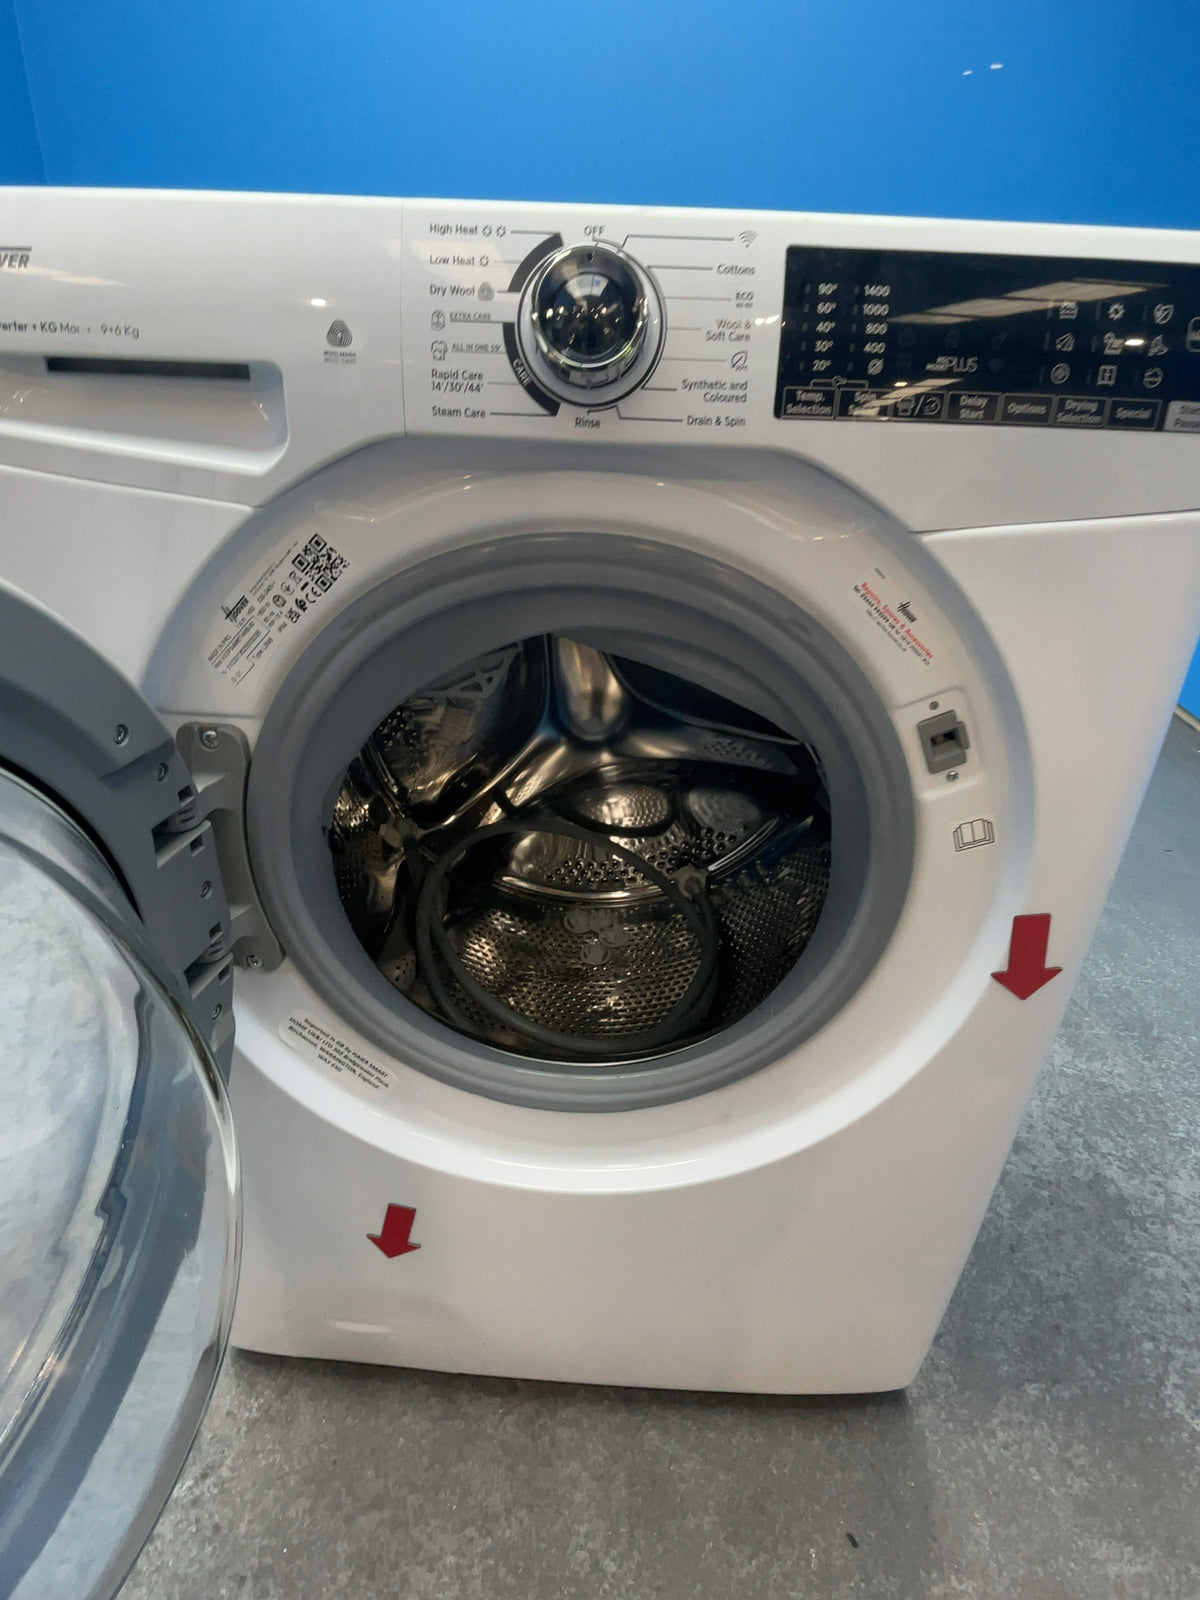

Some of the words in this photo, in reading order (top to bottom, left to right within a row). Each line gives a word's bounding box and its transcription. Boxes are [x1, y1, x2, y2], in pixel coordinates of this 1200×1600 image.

[429, 223, 452, 236] High
[455, 225, 478, 235] Heat
[584, 225, 605, 236] OFF
[429, 255, 450, 265] Low
[452, 255, 475, 266] Heat
[716, 263, 756, 276] Cottons
[429, 284, 447, 297] Dry
[449, 285, 475, 296] Wool
[735, 291, 754, 301] ECO
[863, 284, 891, 297] 1400
[862, 303, 890, 316] 1000
[40, 321, 58, 334] KG
[716, 318, 742, 329] Wool
[865, 322, 888, 335] 800
[705, 331, 725, 342] Soft
[727, 331, 751, 343] Care
[863, 341, 887, 354] 400
[431, 369, 459, 382] Rapid
[461, 370, 483, 381] Care
[681, 378, 727, 392] Synthetic
[729, 380, 748, 391] and
[703, 392, 748, 403] Coloured
[431, 406, 462, 418] Steam
[464, 407, 486, 418] Care
[785, 403, 832, 416] Selection
[1007, 402, 1048, 415] Options
[1065, 400, 1099, 413] Drying
[575, 417, 601, 429] Rinse
[686, 415, 713, 427] Drain
[724, 417, 746, 429] Spin
[1056, 412, 1103, 425] Selection
